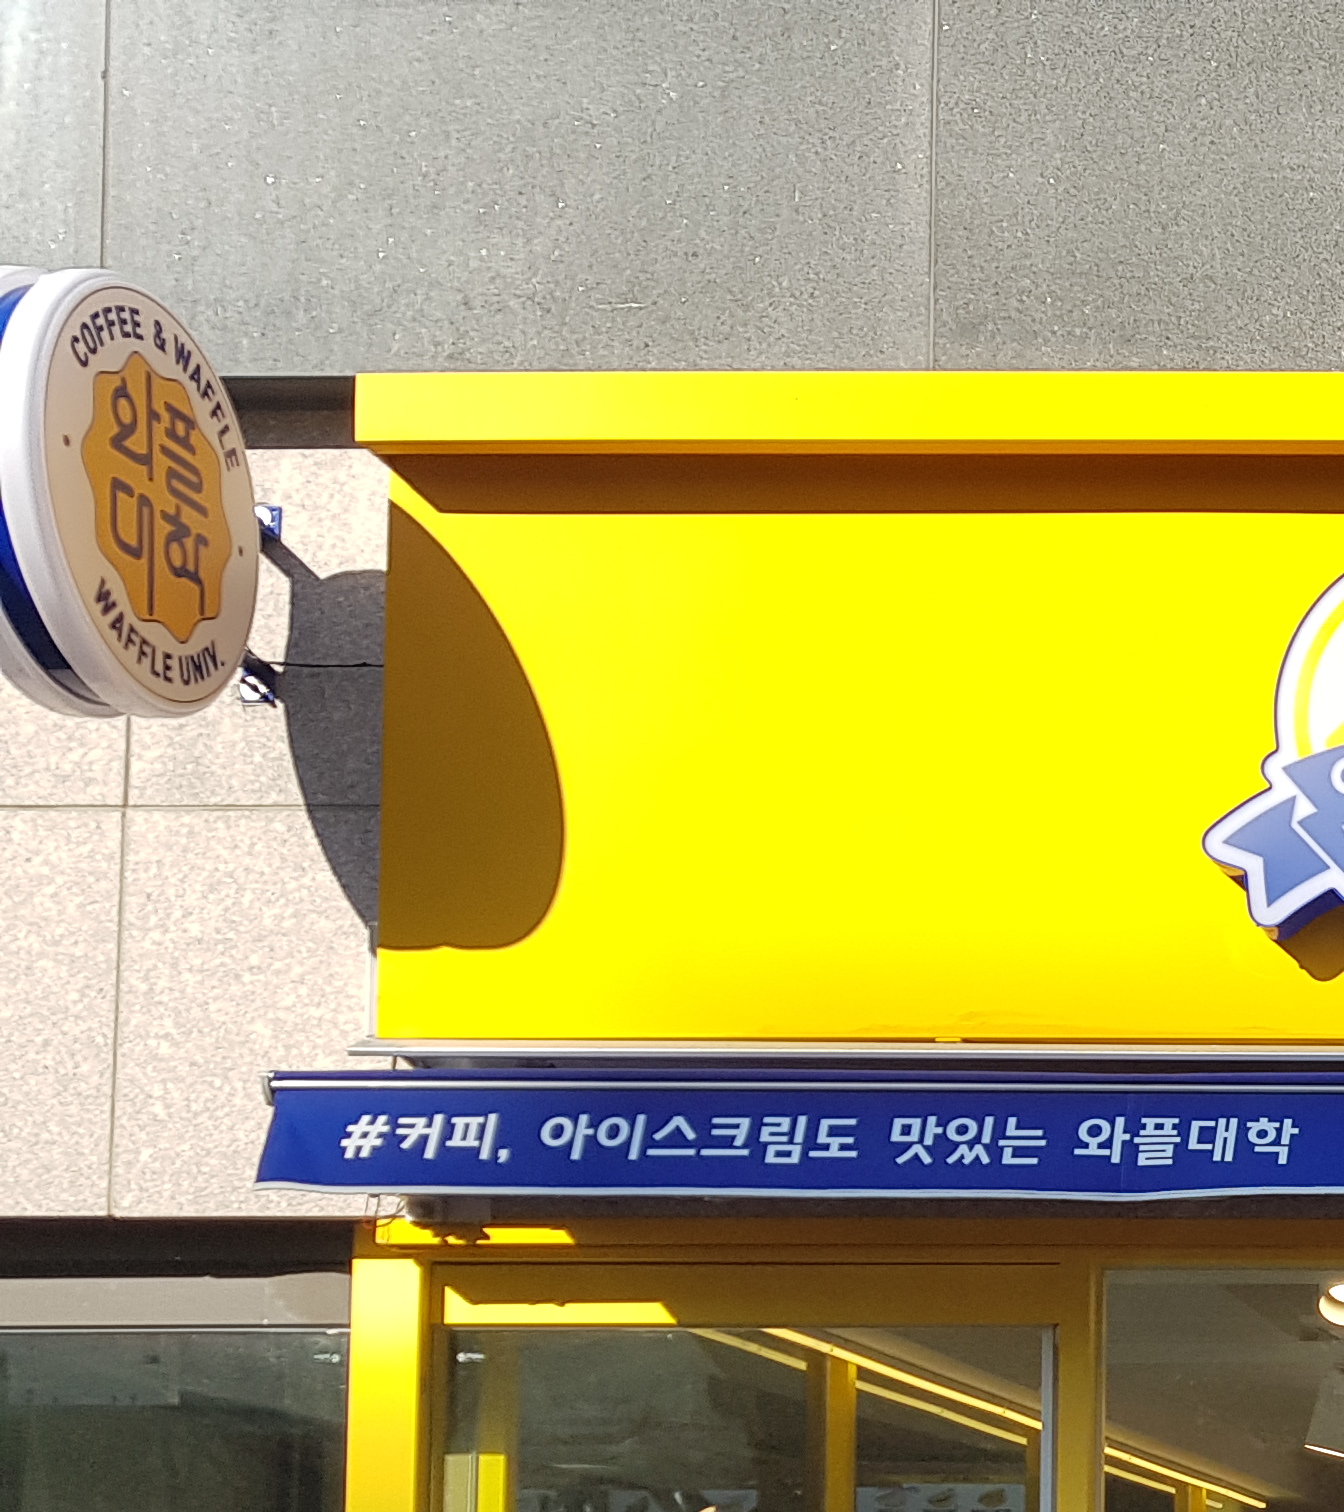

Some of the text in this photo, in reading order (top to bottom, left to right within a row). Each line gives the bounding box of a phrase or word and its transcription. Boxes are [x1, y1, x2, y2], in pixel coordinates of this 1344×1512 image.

[70, 305, 240, 472] COFFEE & WAFFLE
[94, 578, 225, 687] WAFFLE UNIV.
[539, 1112, 861, 1163] 아이스크림도
[890, 1114, 1048, 1167] 맛있는
[1073, 1114, 1300, 1166] 와플대학
